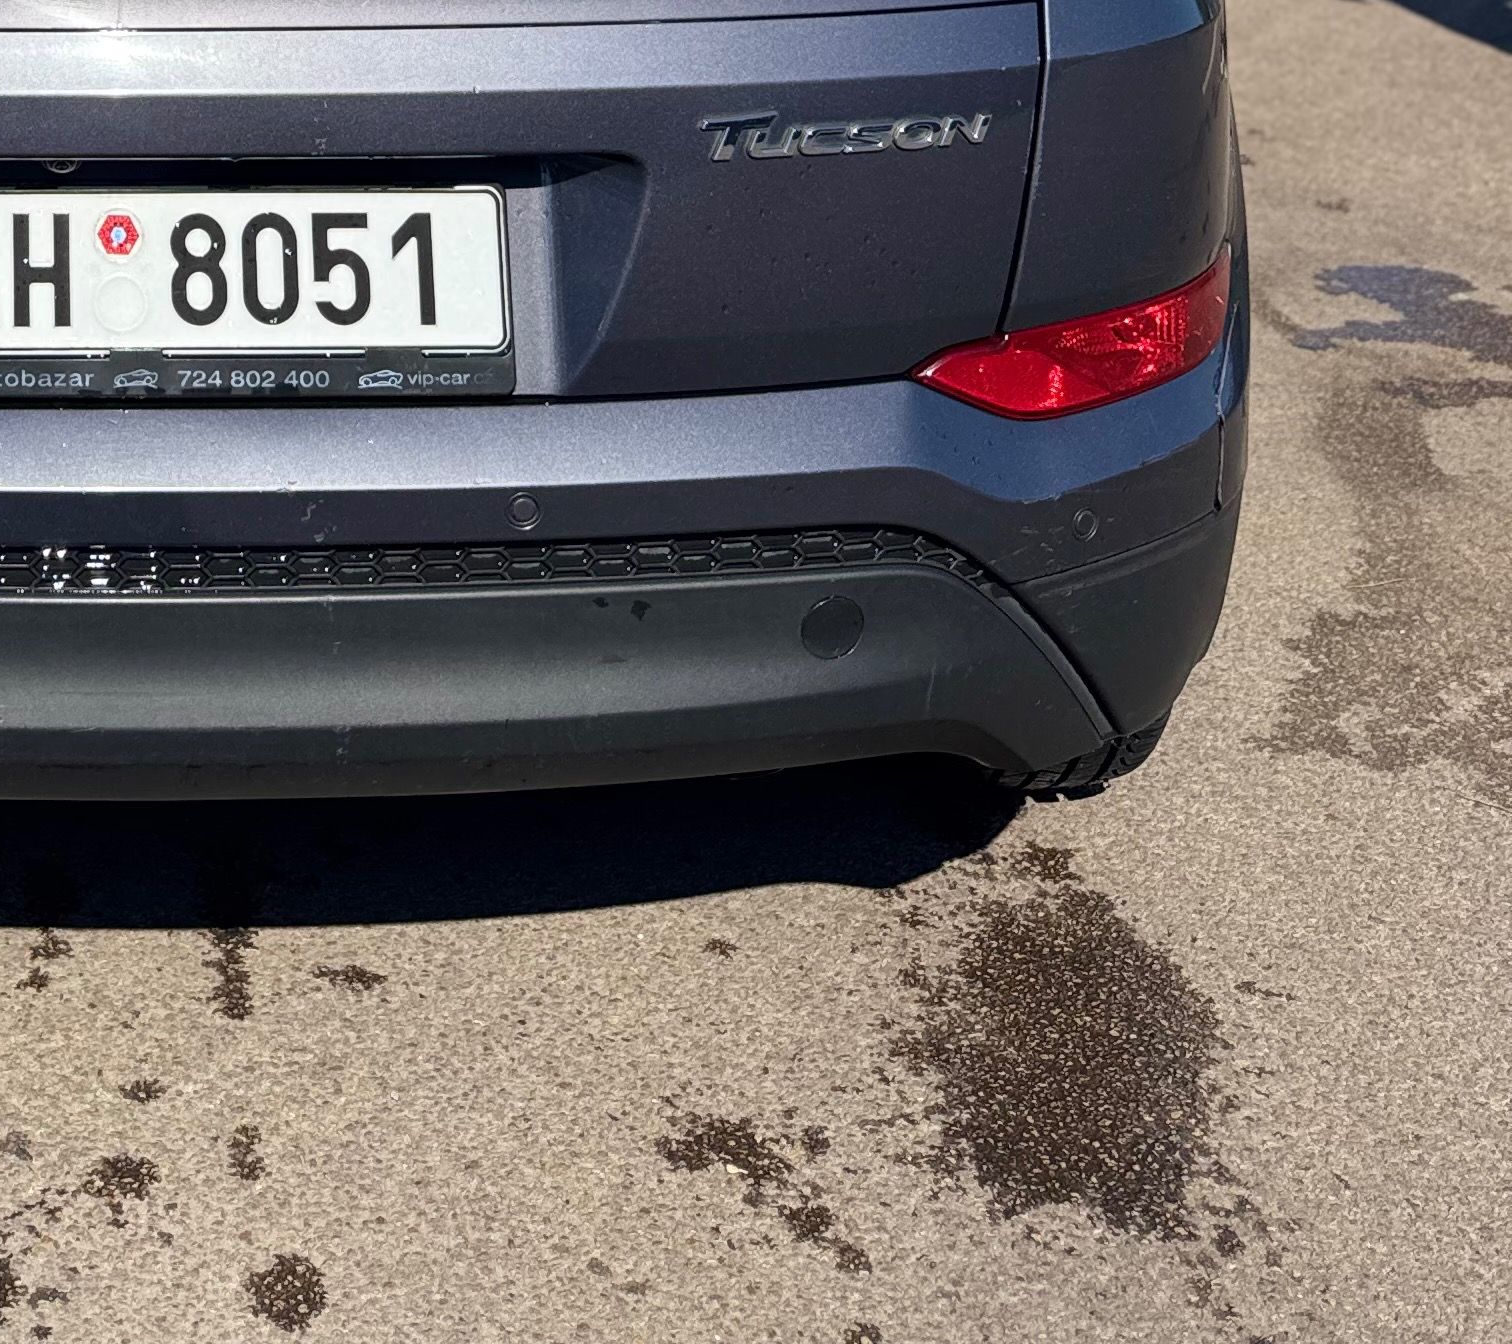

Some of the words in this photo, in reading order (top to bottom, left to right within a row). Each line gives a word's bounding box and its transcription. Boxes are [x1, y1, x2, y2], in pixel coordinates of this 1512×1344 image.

[700, 112, 992, 161] TUCSON
[170, 212, 437, 326] 8051
[178, 369, 222, 389] 724
[230, 369, 276, 389] 802
[283, 369, 330, 389] 400
